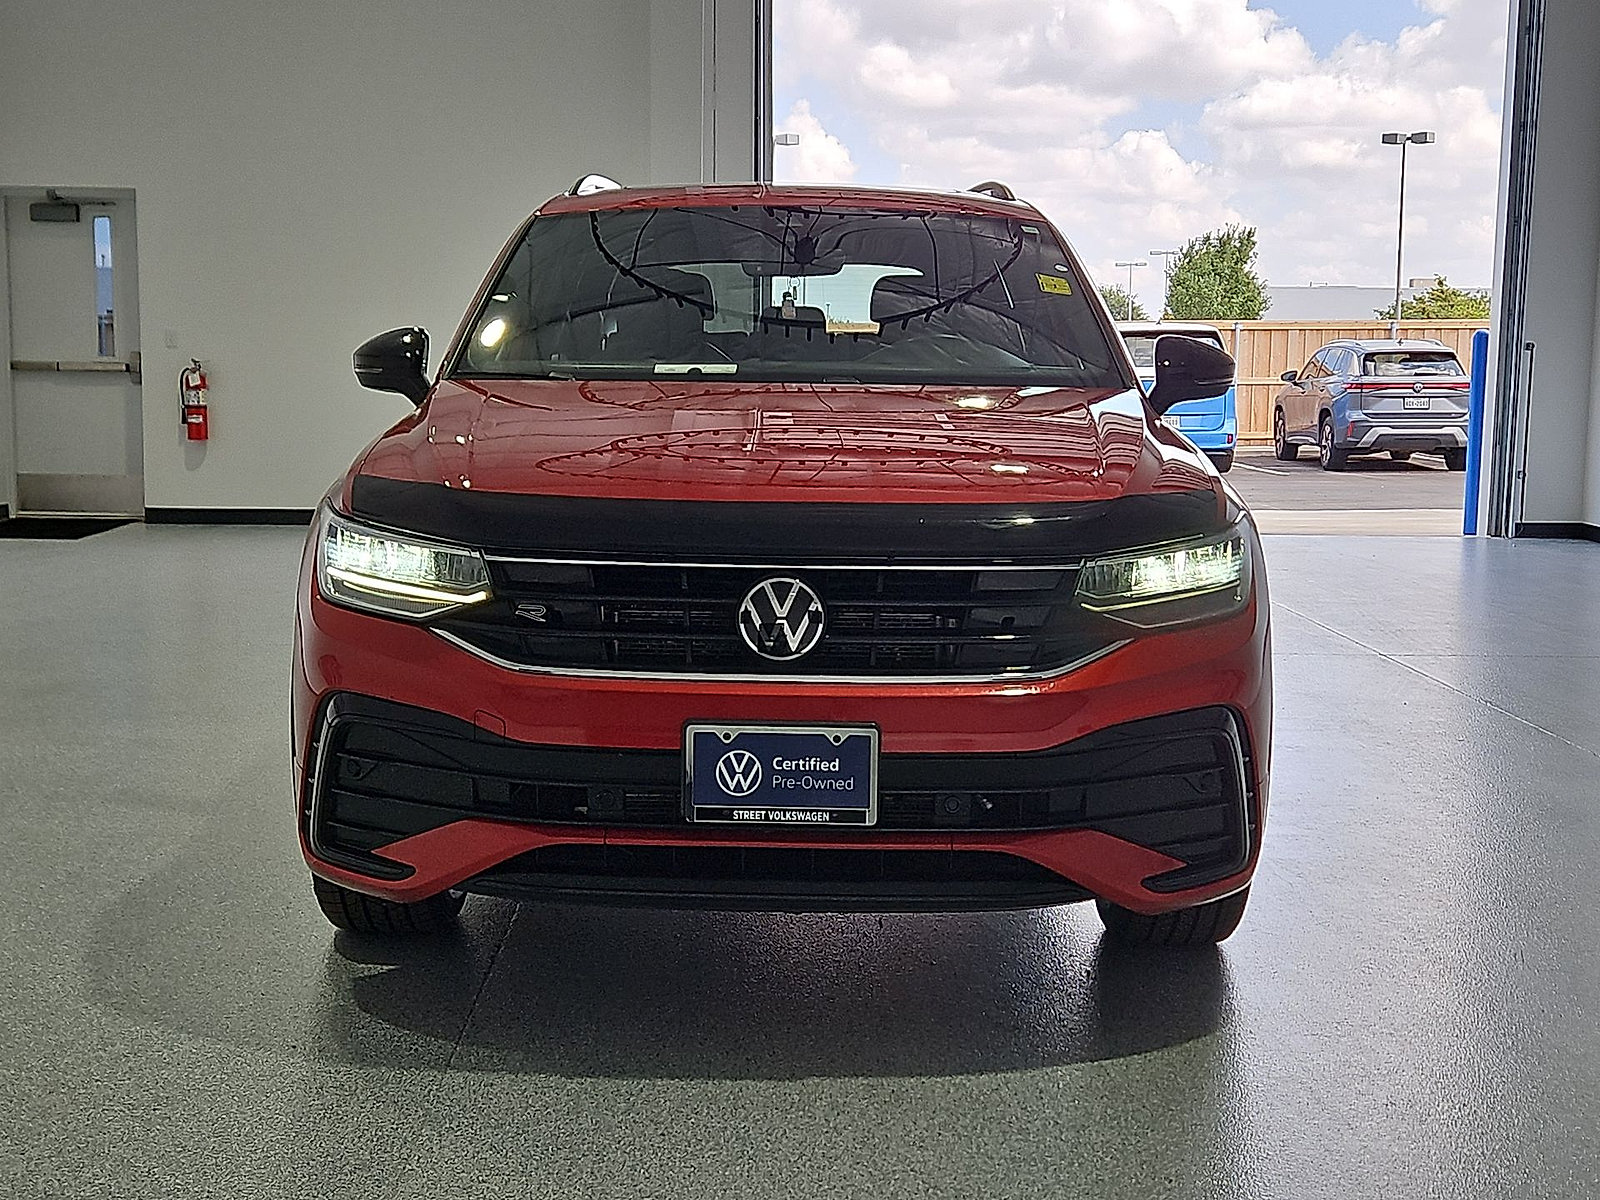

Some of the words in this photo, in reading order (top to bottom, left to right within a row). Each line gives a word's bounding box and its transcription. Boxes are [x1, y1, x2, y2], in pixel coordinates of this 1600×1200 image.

[772, 756, 840, 772] Certified
[716, 750, 762, 796] VW
[772, 775, 854, 790] Pre-Owned
[733, 810, 766, 820] STREET
[768, 811, 830, 821] VOLKSWAGEN
